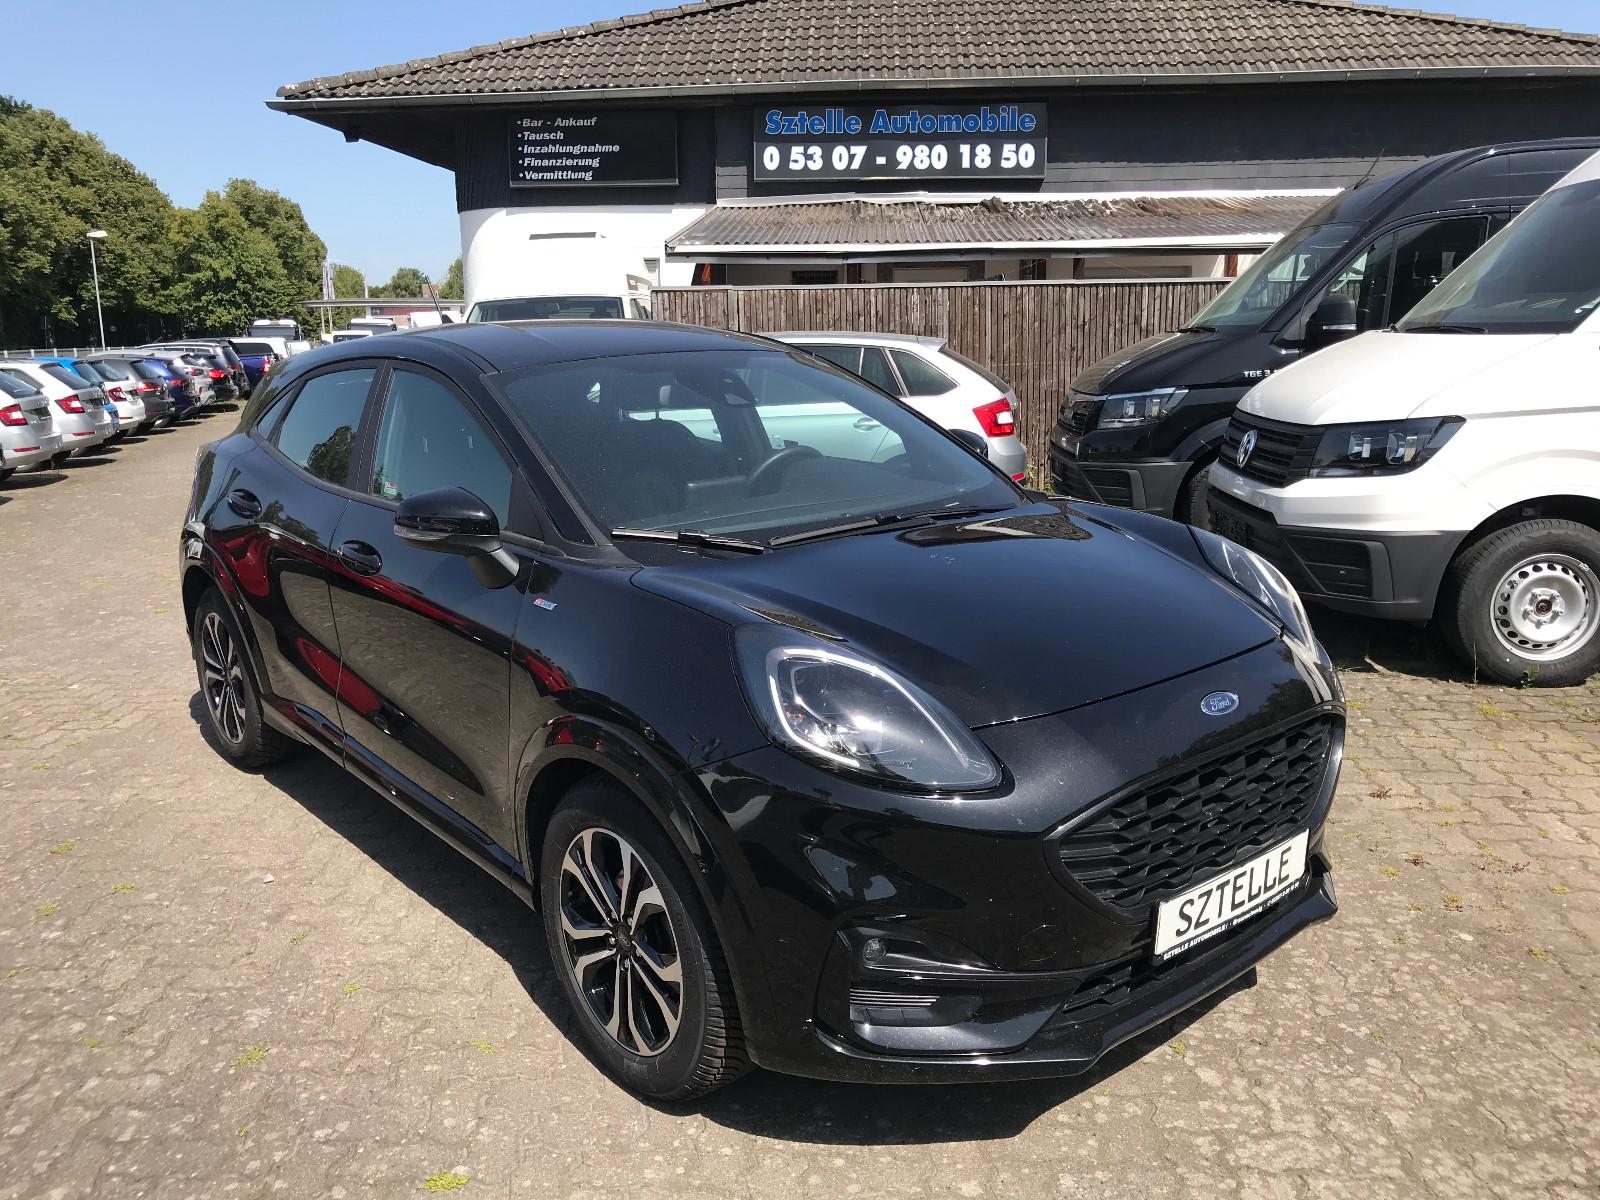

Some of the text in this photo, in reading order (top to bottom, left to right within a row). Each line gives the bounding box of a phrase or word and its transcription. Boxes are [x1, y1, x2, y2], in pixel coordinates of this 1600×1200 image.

[522, 118, 543, 127] Bar
[554, 117, 597, 127] Ankauf
[765, 106, 1037, 135] Sztelle Automobile
[523, 131, 564, 140] Tausch
[523, 144, 620, 155] Inzahlungnahme
[763, 146, 780, 170] 0
[788, 145, 823, 170] 53
[832, 145, 867, 170] 07
[896, 144, 948, 170] 980
[959, 143, 991, 169] 18
[1000, 143, 1036, 168] 50
[524, 157, 600, 168] Finanzierung
[525, 170, 593, 181] Vermittlung
[1243, 370, 1263, 378] TGE
[1175, 846, 1292, 937] SZTELLE
